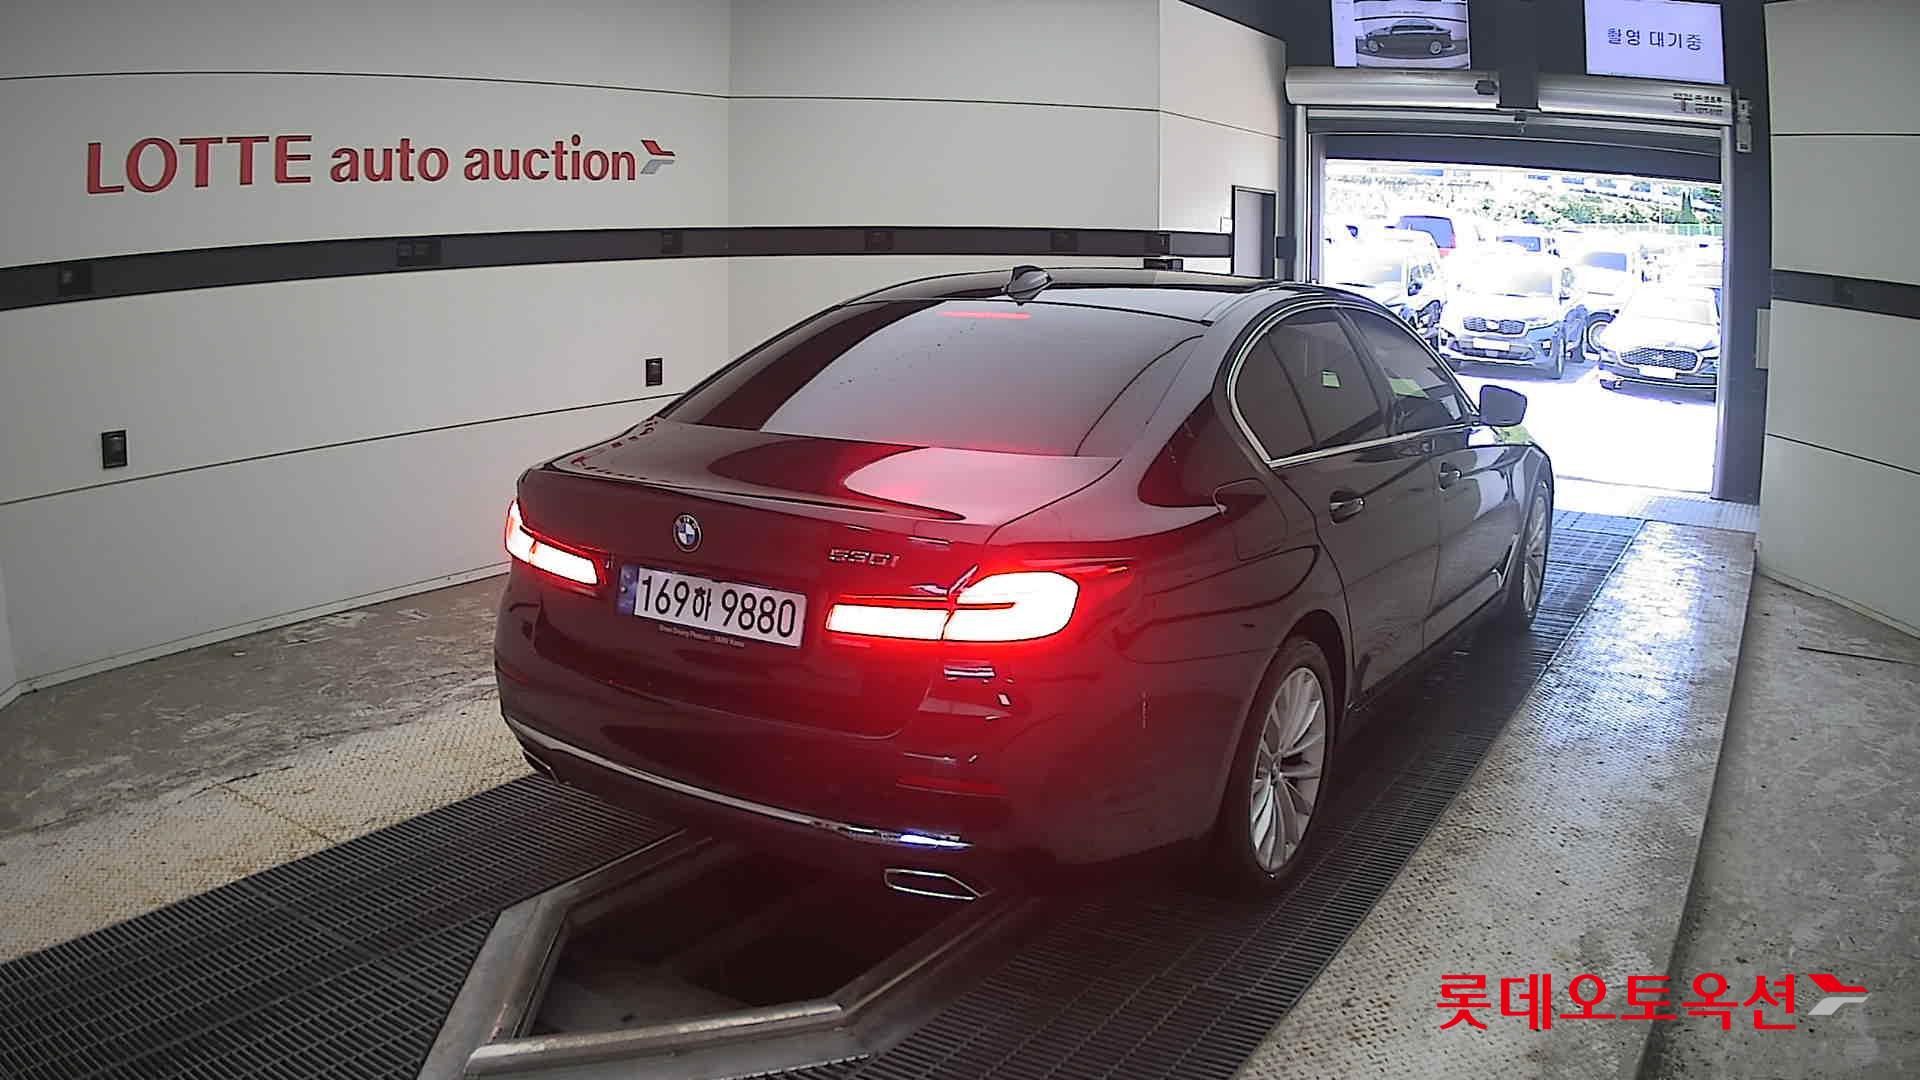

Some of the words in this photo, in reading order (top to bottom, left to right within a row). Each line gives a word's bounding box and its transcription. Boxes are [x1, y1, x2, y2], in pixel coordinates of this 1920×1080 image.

[1649, 31, 1702, 51] 대기중
[86, 135, 313, 195] LOTTE
[330, 137, 449, 183] auto
[463, 133, 637, 182] auction
[642, 575, 713, 622] 169하
[721, 589, 797, 638] 9880
